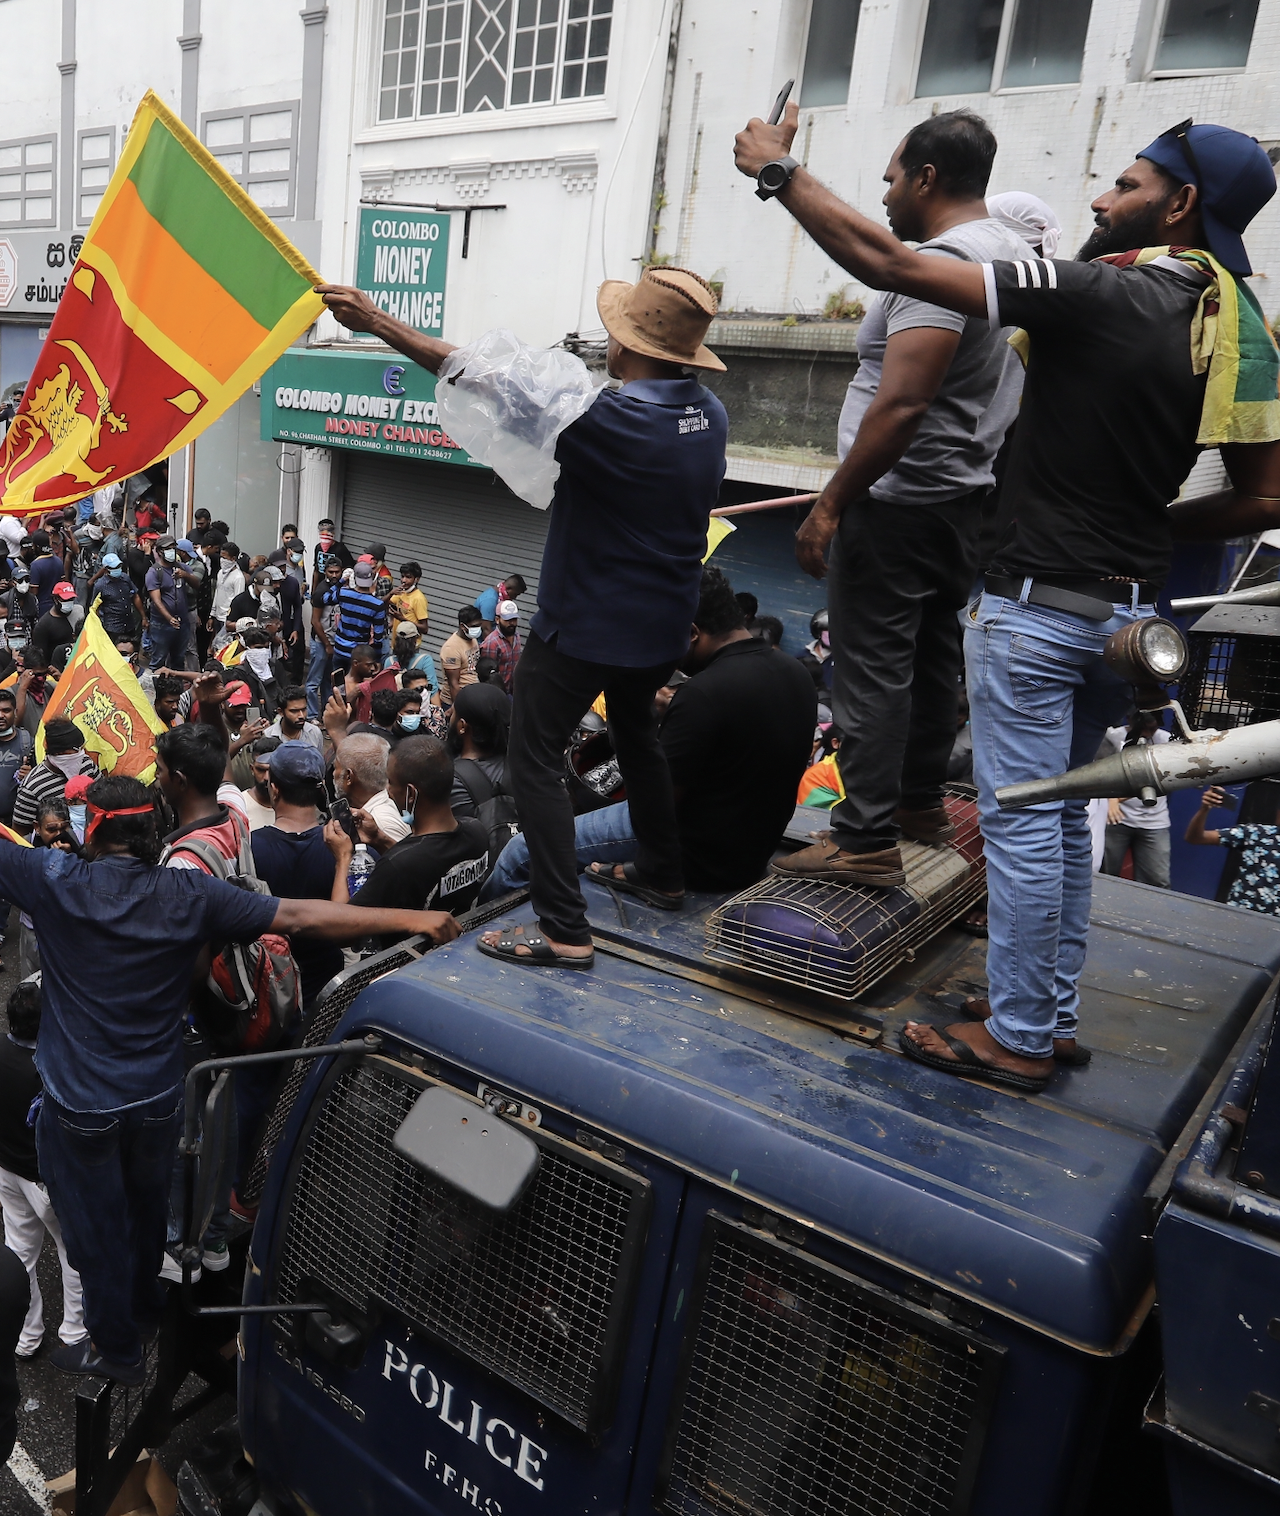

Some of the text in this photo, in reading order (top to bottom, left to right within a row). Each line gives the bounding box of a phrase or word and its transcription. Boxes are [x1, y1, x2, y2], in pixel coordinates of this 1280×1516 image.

[372, 219, 439, 241] COLOMBO
[374, 245, 432, 284] MONEY
[362, 290, 443, 328] XCHANGE
[276, 387, 342, 414] COLOMBO
[344, 394, 402, 420] MONEY
[279, 429, 290, 437] NO.
[328, 436, 349, 446] STREET,
[350, 439, 381, 449] COLOMBO
[396, 445, 408, 453] TEL:
[424, 449, 452, 459] 2438627
[325, 417, 380, 438] MONEY
[381, 1340, 548, 1491] POLICE
